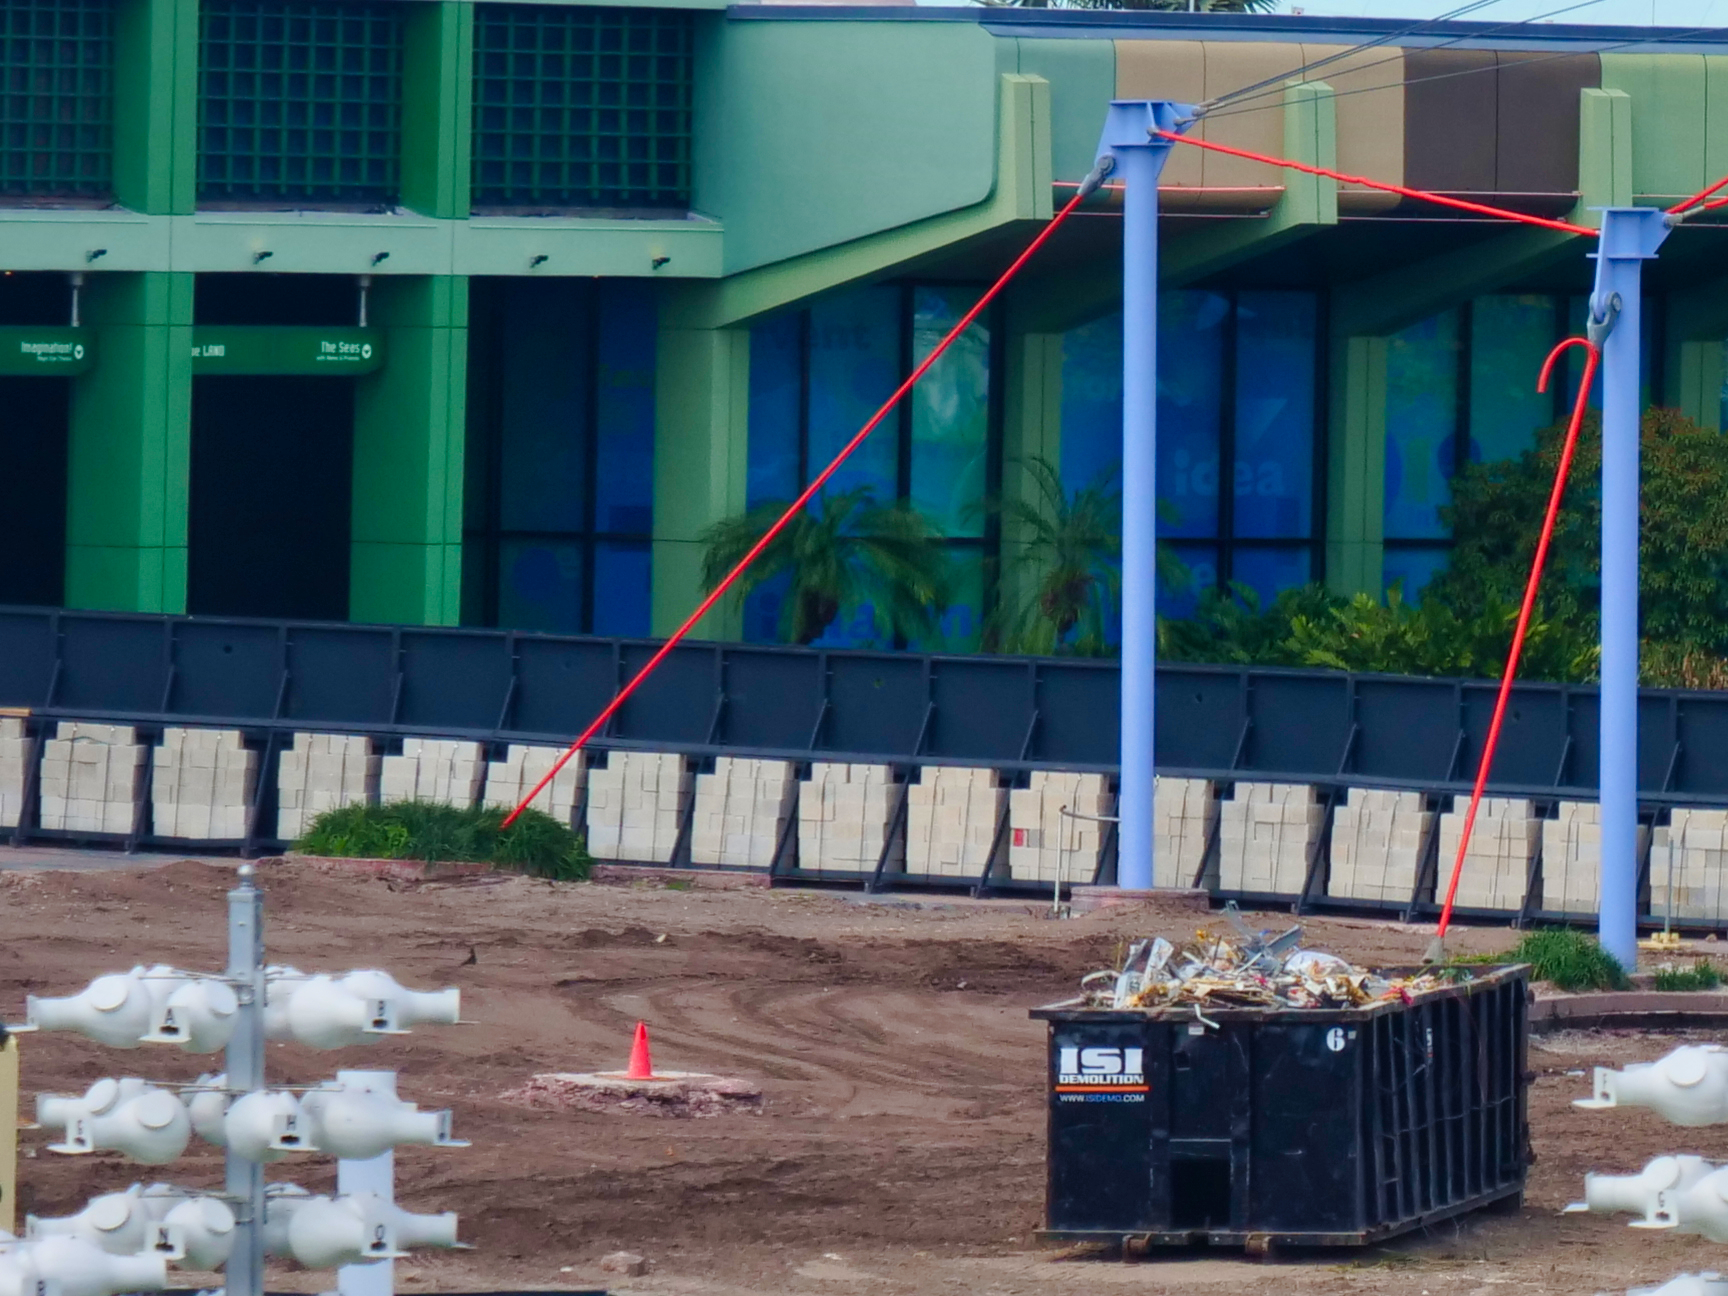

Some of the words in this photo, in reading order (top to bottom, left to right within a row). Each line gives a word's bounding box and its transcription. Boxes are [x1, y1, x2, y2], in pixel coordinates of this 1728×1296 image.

[321, 341, 336, 353] The
[339, 341, 360, 353] Seas
[165, 1008, 175, 1024] A
[1326, 1027, 1345, 1052] 6
[1060, 1048, 1143, 1074] ISI
[1059, 1075, 1144, 1085] DEMOLITION
[1060, 1094, 1145, 1102] WWW.ISIDEMO.COM
[286, 1114, 296, 1131] H
[159, 1227, 168, 1244] N
